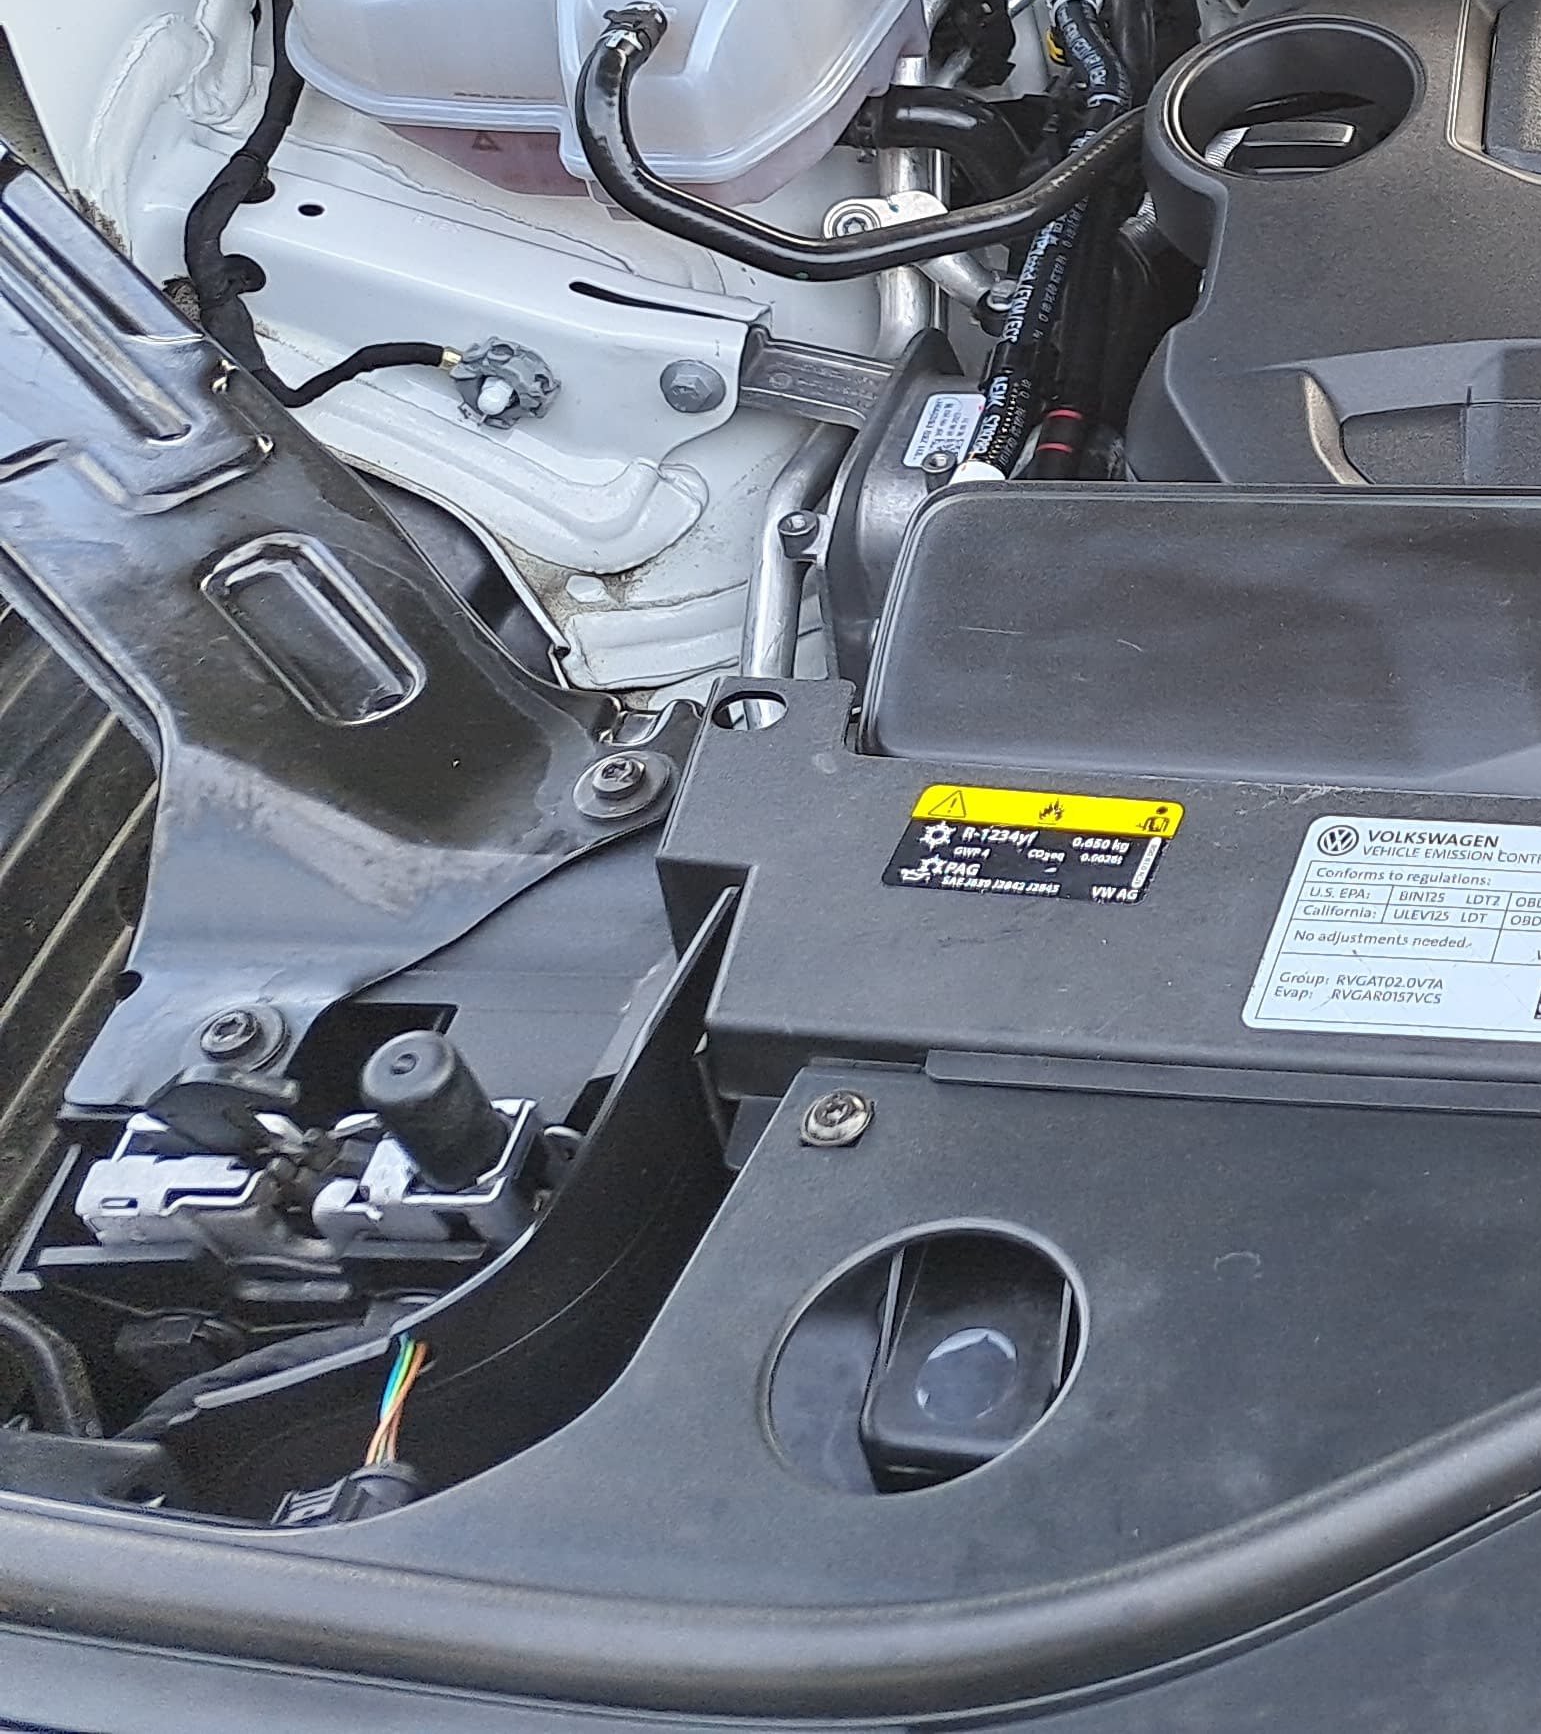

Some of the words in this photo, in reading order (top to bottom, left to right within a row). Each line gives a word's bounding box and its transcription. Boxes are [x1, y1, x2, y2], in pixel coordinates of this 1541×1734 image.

[959, 826, 1039, 847] R-1234yf
[1110, 839, 1131, 852] kg
[1365, 829, 1499, 847] VOLKSWAGEN
[1360, 845, 1420, 857] VEHICLE
[1424, 848, 1493, 861] EMISSION
[943, 862, 981, 875] PAG
[1315, 866, 1386, 879] Conforms
[1388, 869, 1405, 880] to
[1405, 871, 1492, 887] regulations:
[1115, 888, 1139, 901] AG
[1309, 887, 1337, 897] U.S.
[1398, 891, 1446, 902] BIN125
[1301, 904, 1378, 918] California:
[1392, 909, 1450, 921] ULEV125
[1459, 912, 1487, 923] LDT
[1293, 929, 1316, 941] No
[1316, 930, 1409, 948] adjustments
[1277, 971, 1330, 987] Group:
[1272, 986, 1314, 1000] Evap:
